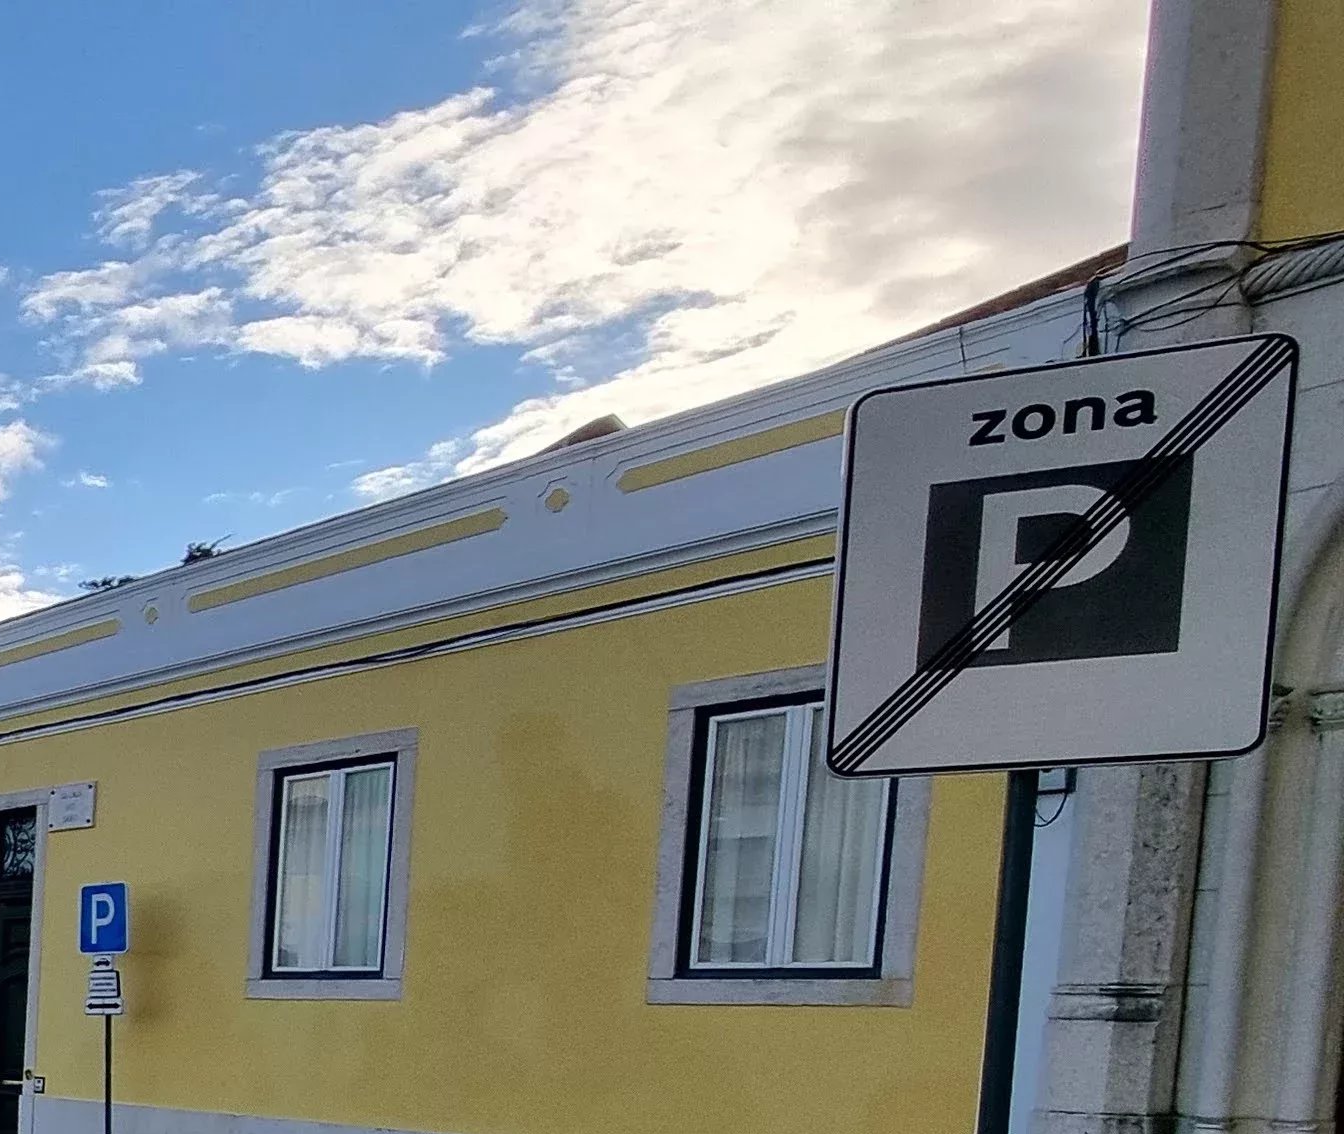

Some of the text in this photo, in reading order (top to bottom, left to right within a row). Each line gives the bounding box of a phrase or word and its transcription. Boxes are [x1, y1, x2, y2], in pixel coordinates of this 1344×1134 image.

[968, 388, 1159, 447] zona
[973, 483, 1131, 652] P
[90, 892, 115, 945] P
